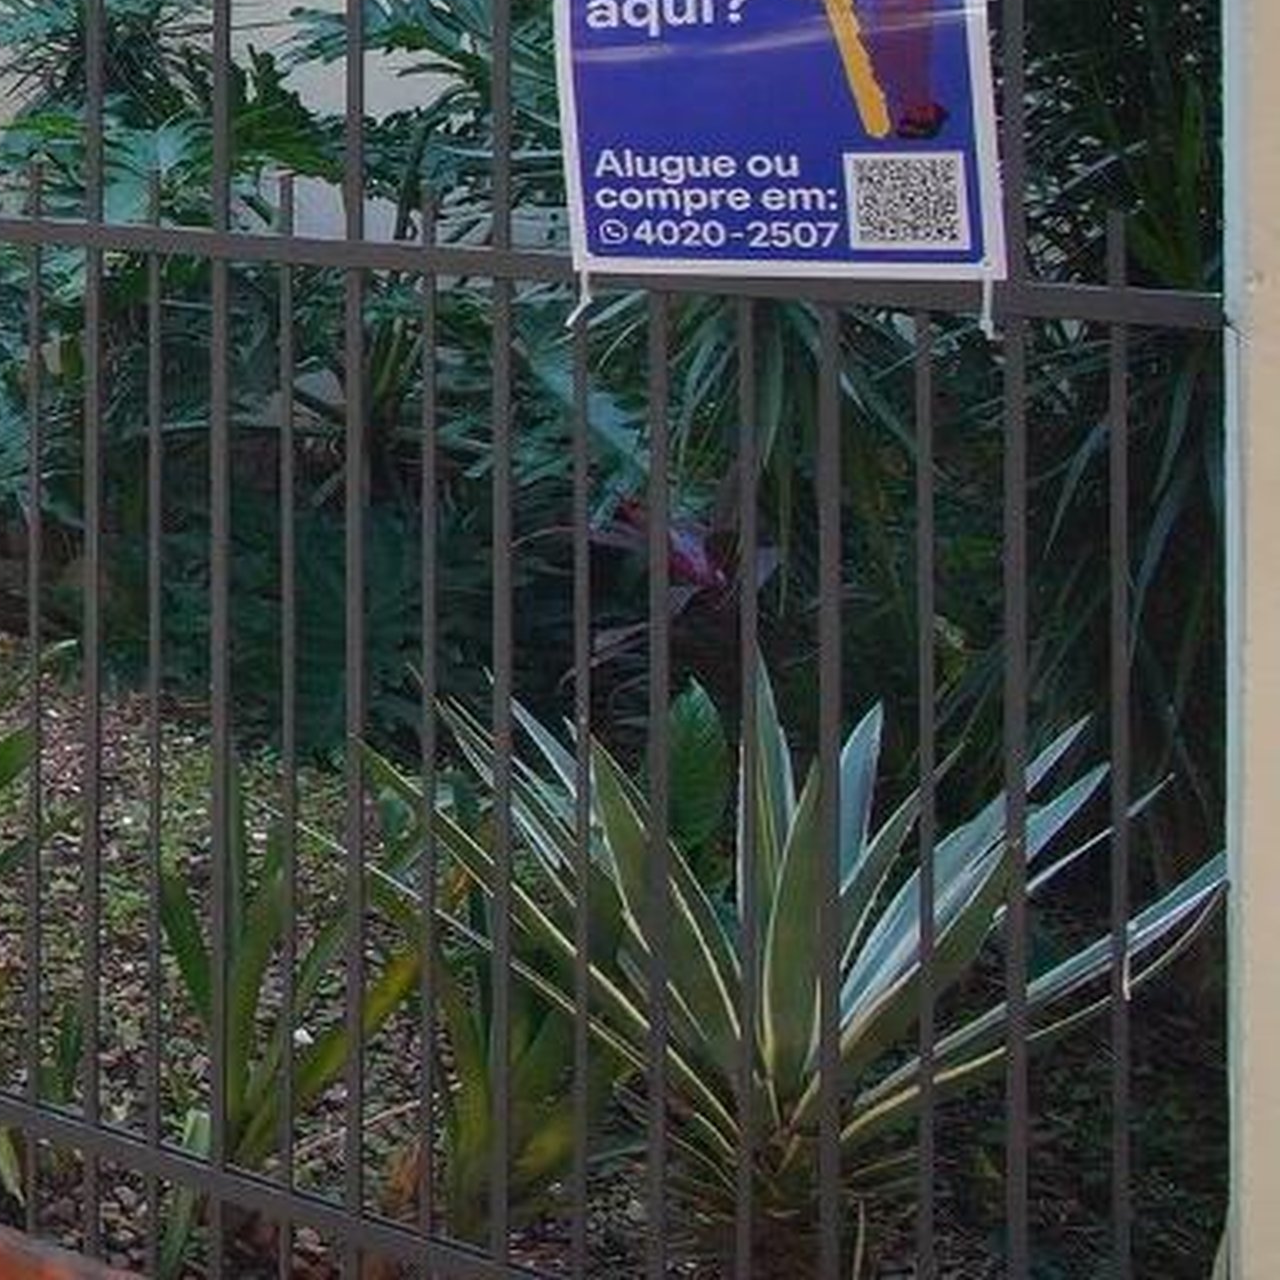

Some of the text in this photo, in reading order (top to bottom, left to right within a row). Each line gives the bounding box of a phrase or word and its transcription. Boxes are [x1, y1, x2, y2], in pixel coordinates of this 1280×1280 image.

[594, 149, 800, 186] Alugue ou
[594, 183, 839, 217] compre em:
[633, 219, 840, 249] 4020-2507
